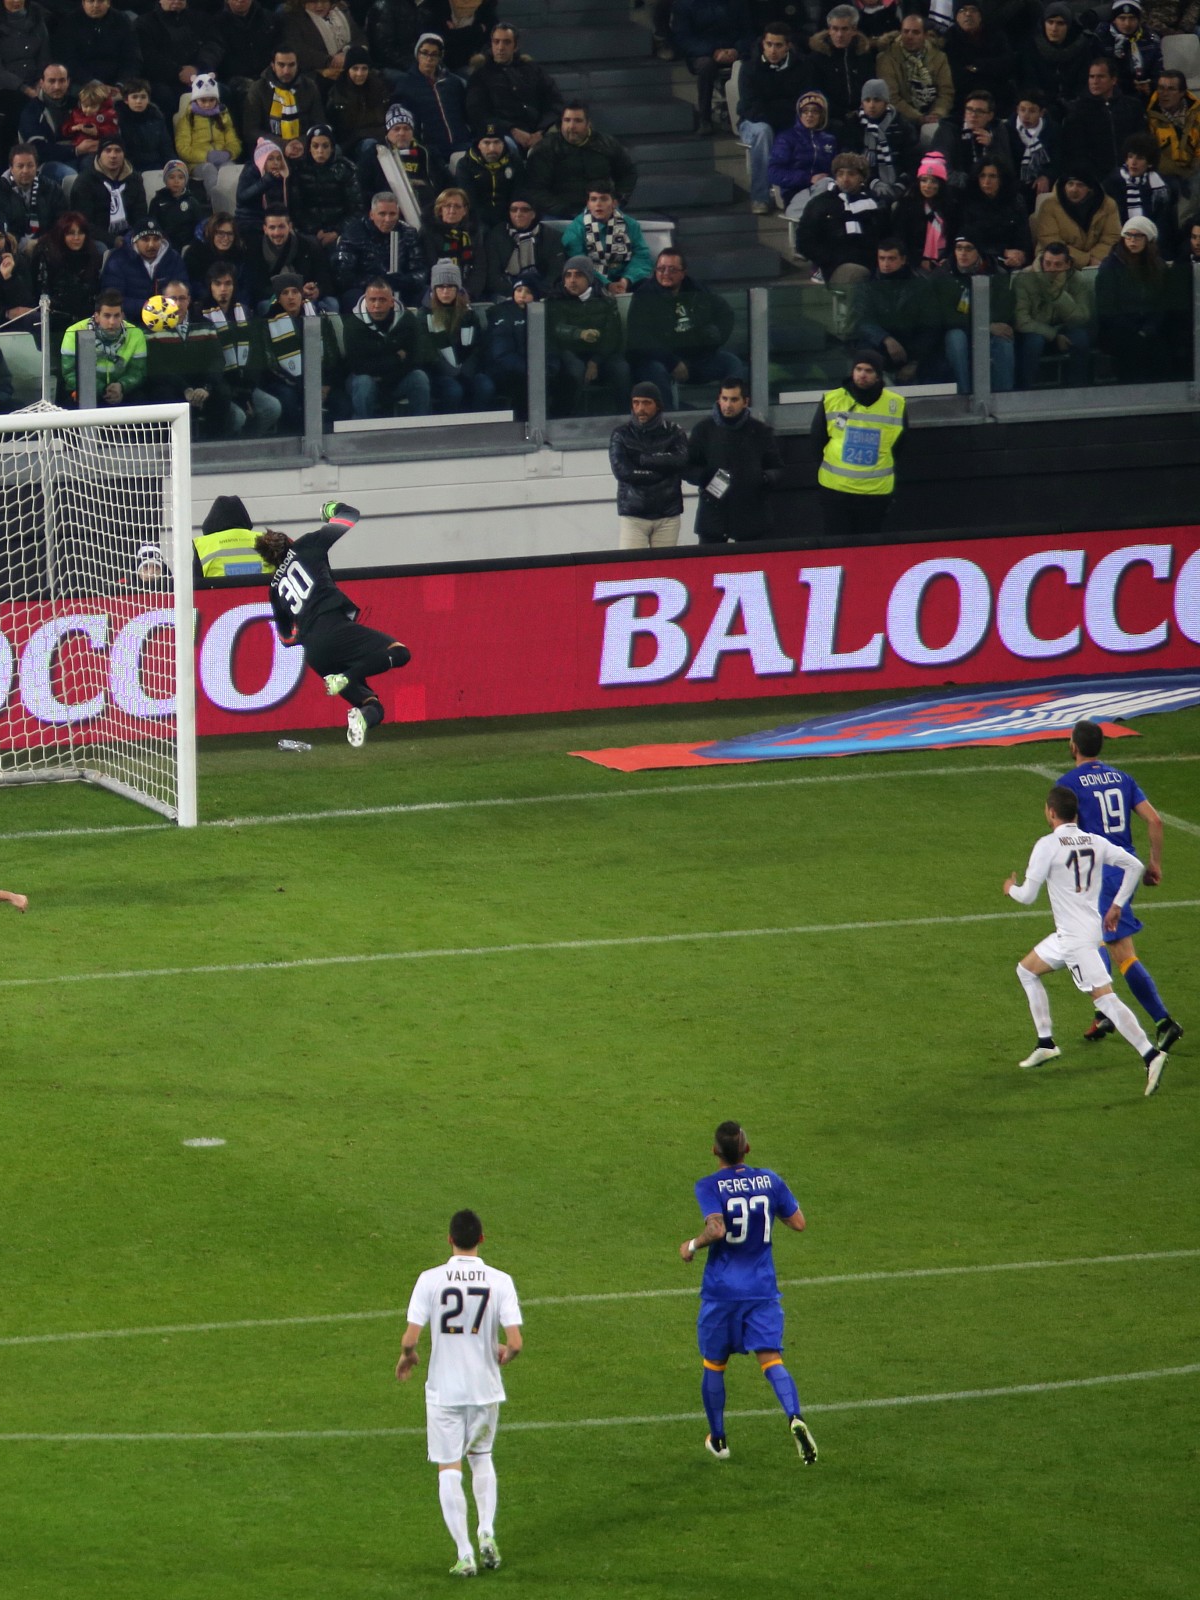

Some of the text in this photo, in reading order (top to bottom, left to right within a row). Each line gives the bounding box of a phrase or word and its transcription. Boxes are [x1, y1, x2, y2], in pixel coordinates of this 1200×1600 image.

[845, 447, 874, 465] 243
[278, 560, 315, 615] 30
[592, 543, 1200, 686] BALOCC
[1078, 771, 1123, 787] BONUCCI
[1093, 787, 1126, 834] 19
[1065, 847, 1095, 893] 17
[717, 1174, 772, 1194] PEREYRA
[725, 1194, 771, 1245] 37
[446, 1270, 486, 1282] VALOTI
[441, 1286, 491, 1335] 27
